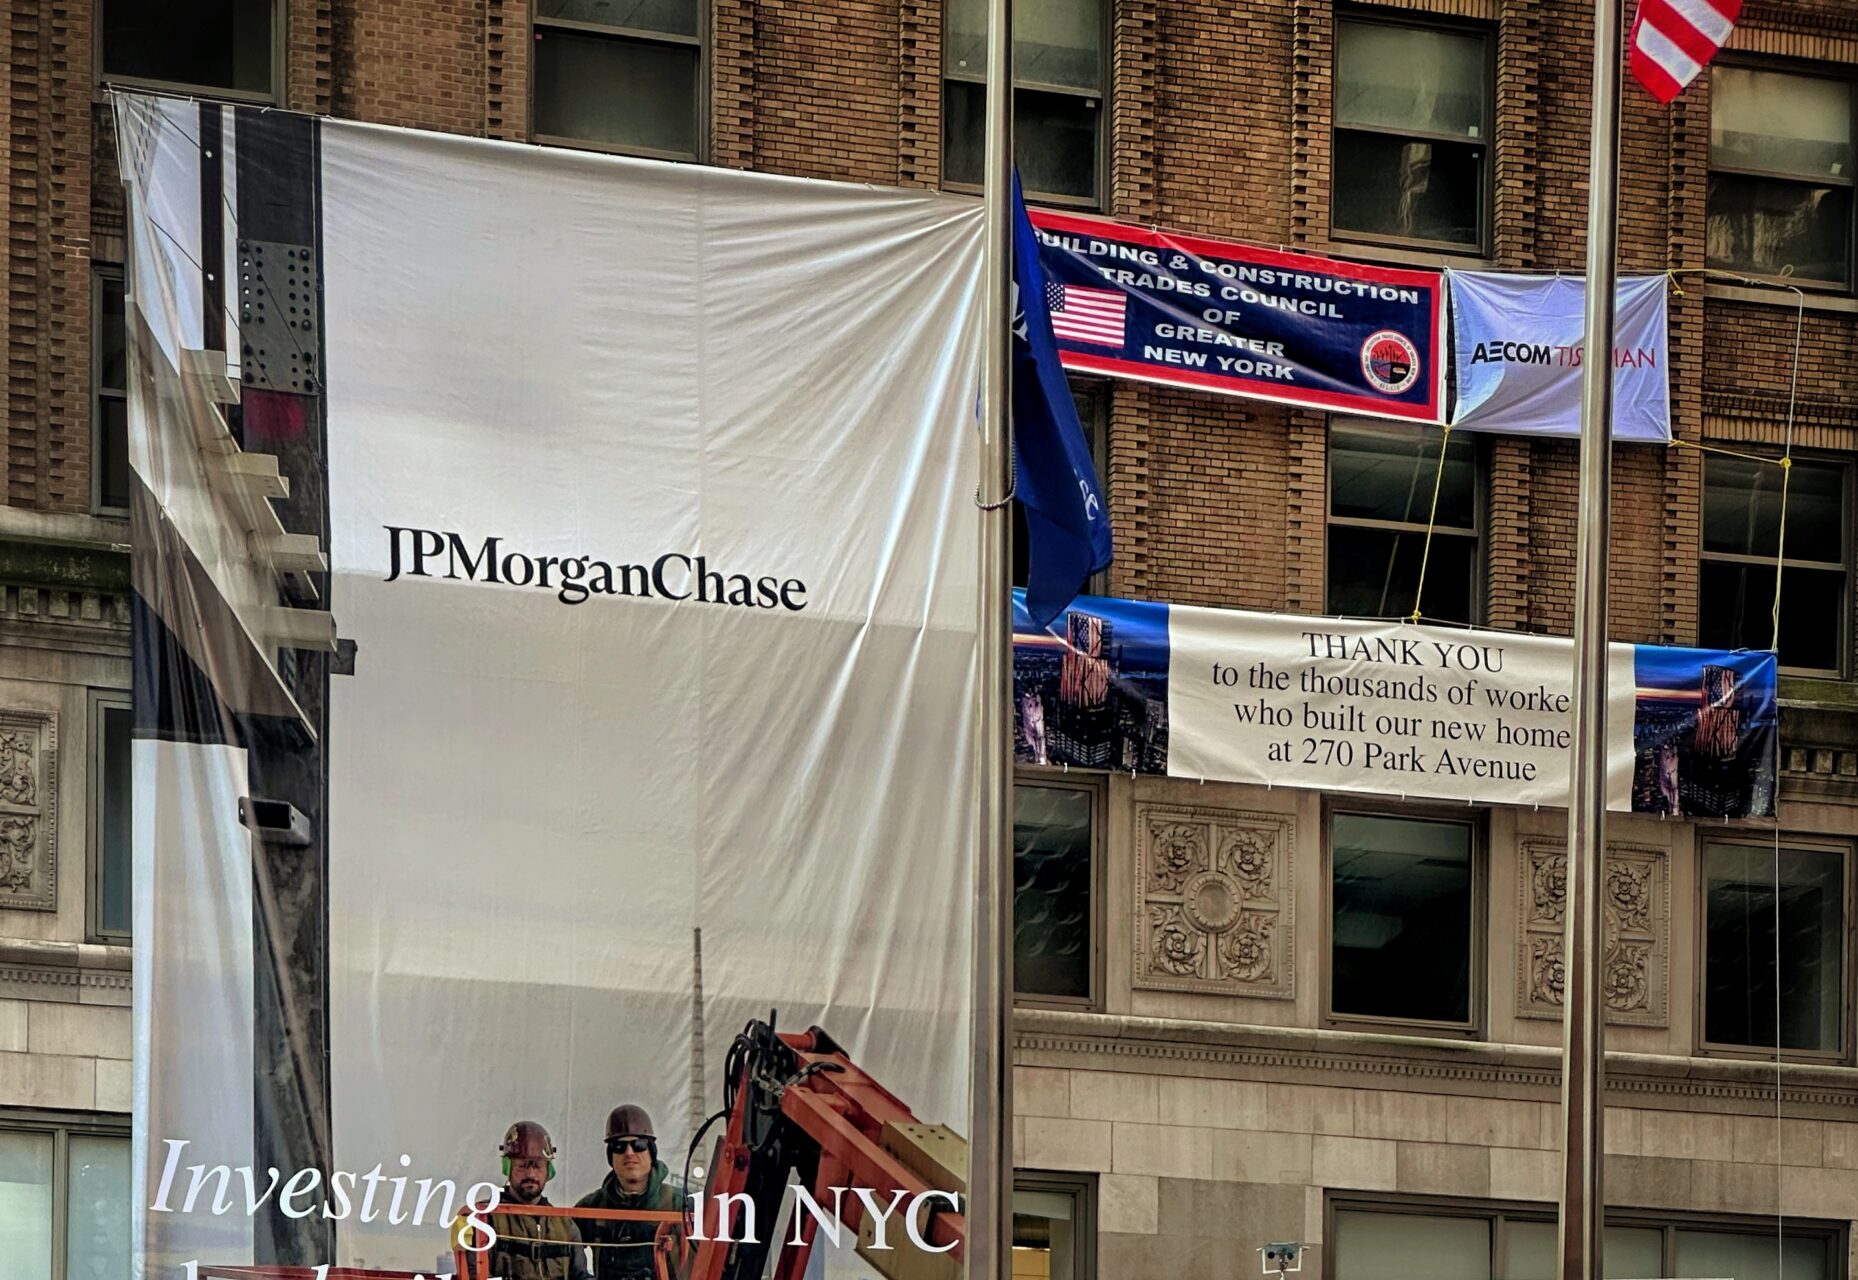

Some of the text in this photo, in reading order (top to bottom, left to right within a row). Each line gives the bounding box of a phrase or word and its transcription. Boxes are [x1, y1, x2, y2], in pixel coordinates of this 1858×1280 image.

[1098, 266, 1344, 319] TRADES COUNCIL
[1169, 254, 1189, 271] &
[1199, 260, 1418, 305] CONSTRUCTION
[1154, 323, 1285, 358] GREATER
[1202, 308, 1241, 325] OF
[1143, 345, 1295, 381] NEW YORK
[1470, 341, 1656, 369] AECOM TISAN
[382, 525, 809, 612] JPMorganChase
[1302, 632, 1505, 673] THANK YOU
[1212, 661, 1573, 714] to the thousands of worke
[1234, 698, 1571, 749] who built our new home
[1268, 737, 1537, 782] at 270 Park Avenue
[149, 1138, 960, 1254] Investing in NYC
